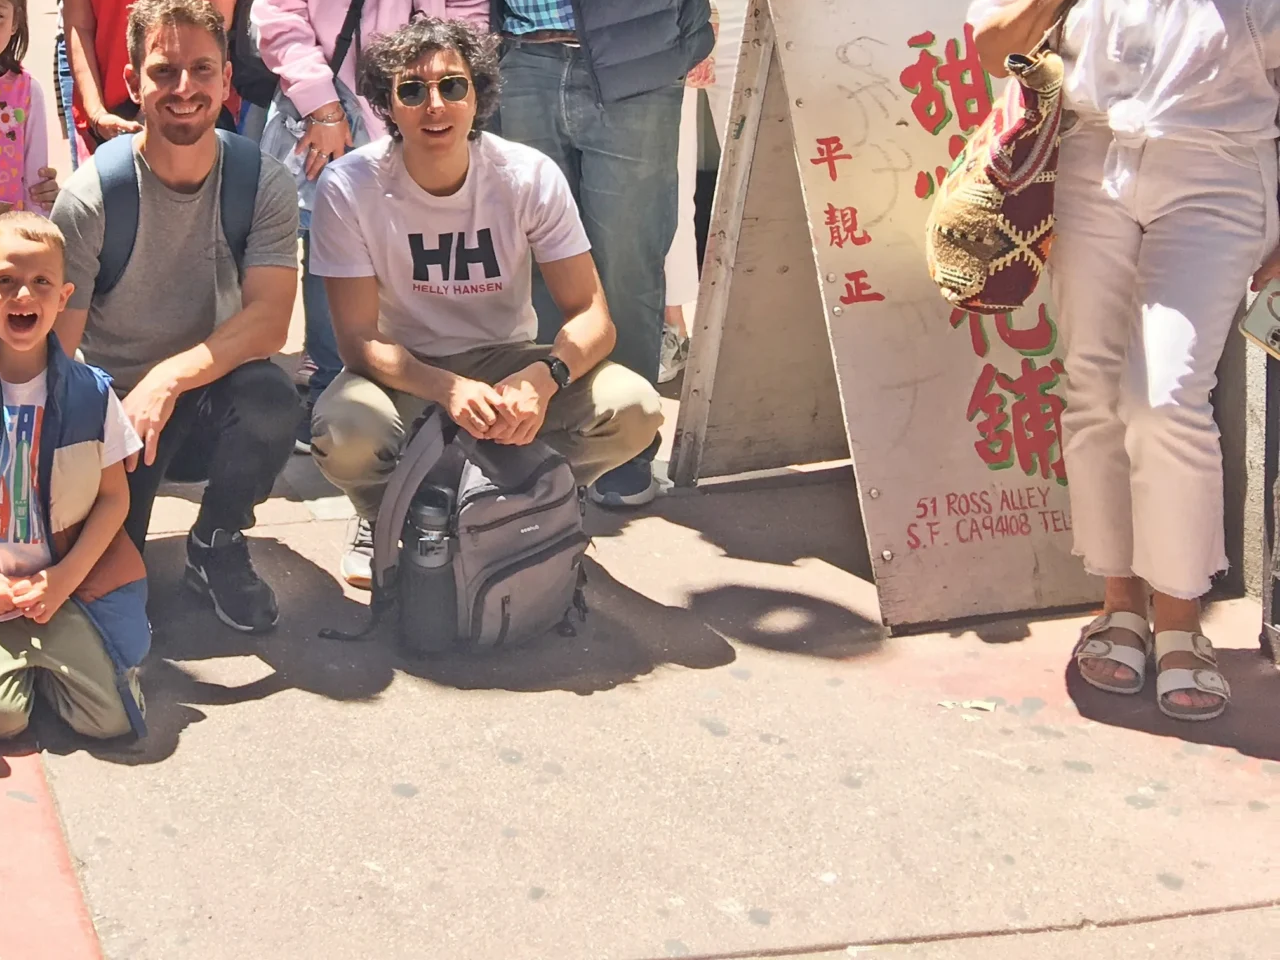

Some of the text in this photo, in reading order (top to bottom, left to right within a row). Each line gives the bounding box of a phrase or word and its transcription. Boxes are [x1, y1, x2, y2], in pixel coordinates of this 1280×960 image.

[809, 135, 886, 306] 平靚正
[407, 227, 501, 281] HH
[412, 281, 503, 295] HELLY HANSEN
[915, 486, 1051, 519] 51 ROSS ALLEY
